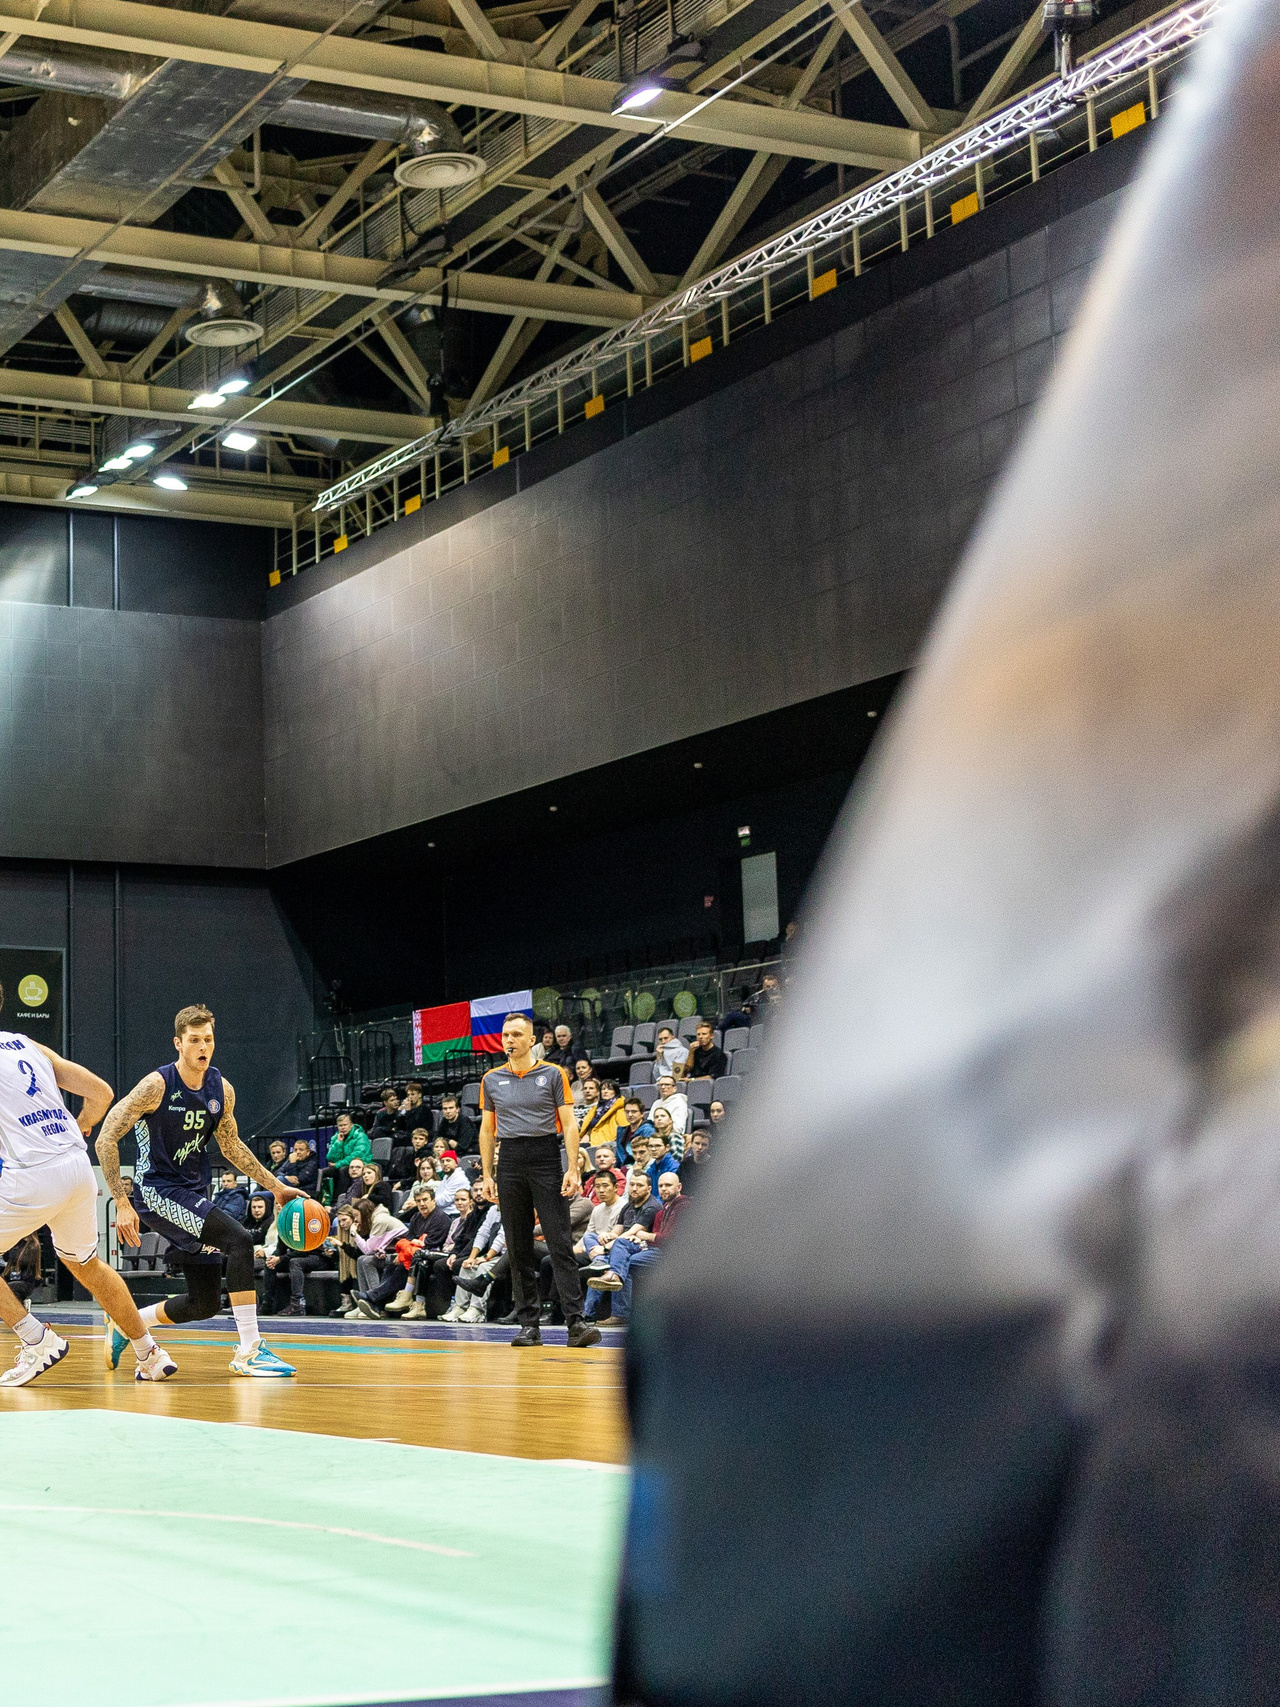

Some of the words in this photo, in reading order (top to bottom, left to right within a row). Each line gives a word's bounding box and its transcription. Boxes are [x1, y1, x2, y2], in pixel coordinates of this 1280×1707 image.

[17, 1059, 43, 1098] 2
[40, 1122, 69, 1137] REGIO
[182, 1109, 207, 1131] 95
